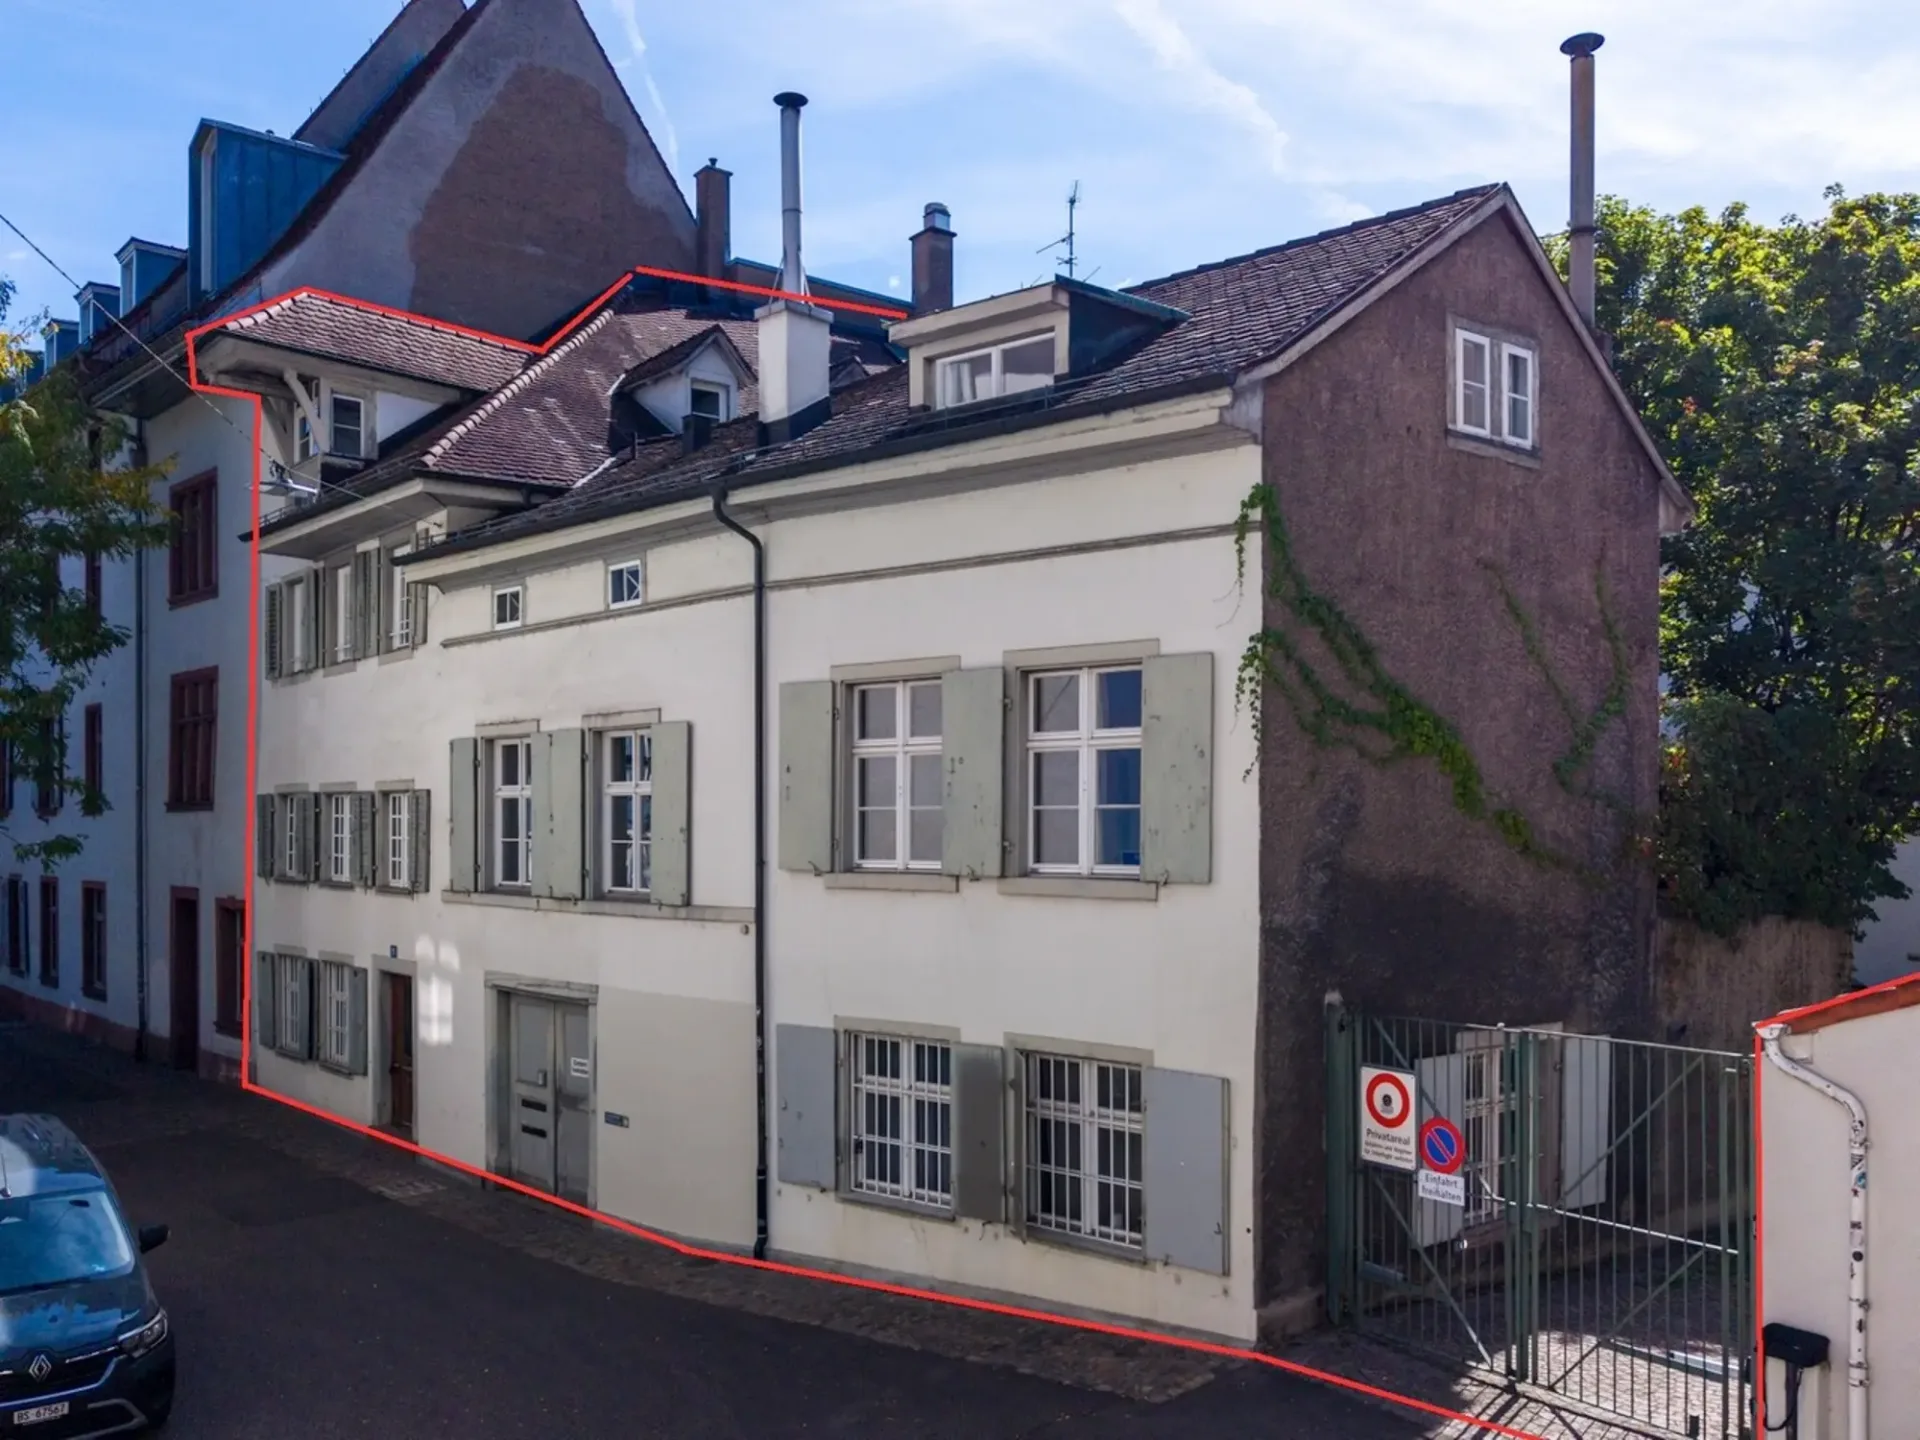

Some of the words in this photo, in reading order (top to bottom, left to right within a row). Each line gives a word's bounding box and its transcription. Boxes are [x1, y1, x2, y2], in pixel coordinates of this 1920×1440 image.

[1366, 1127, 1411, 1146] Privatareal
[1425, 1173, 1457, 1189] Einfahrt
[1422, 1185, 1462, 1203] freihalten
